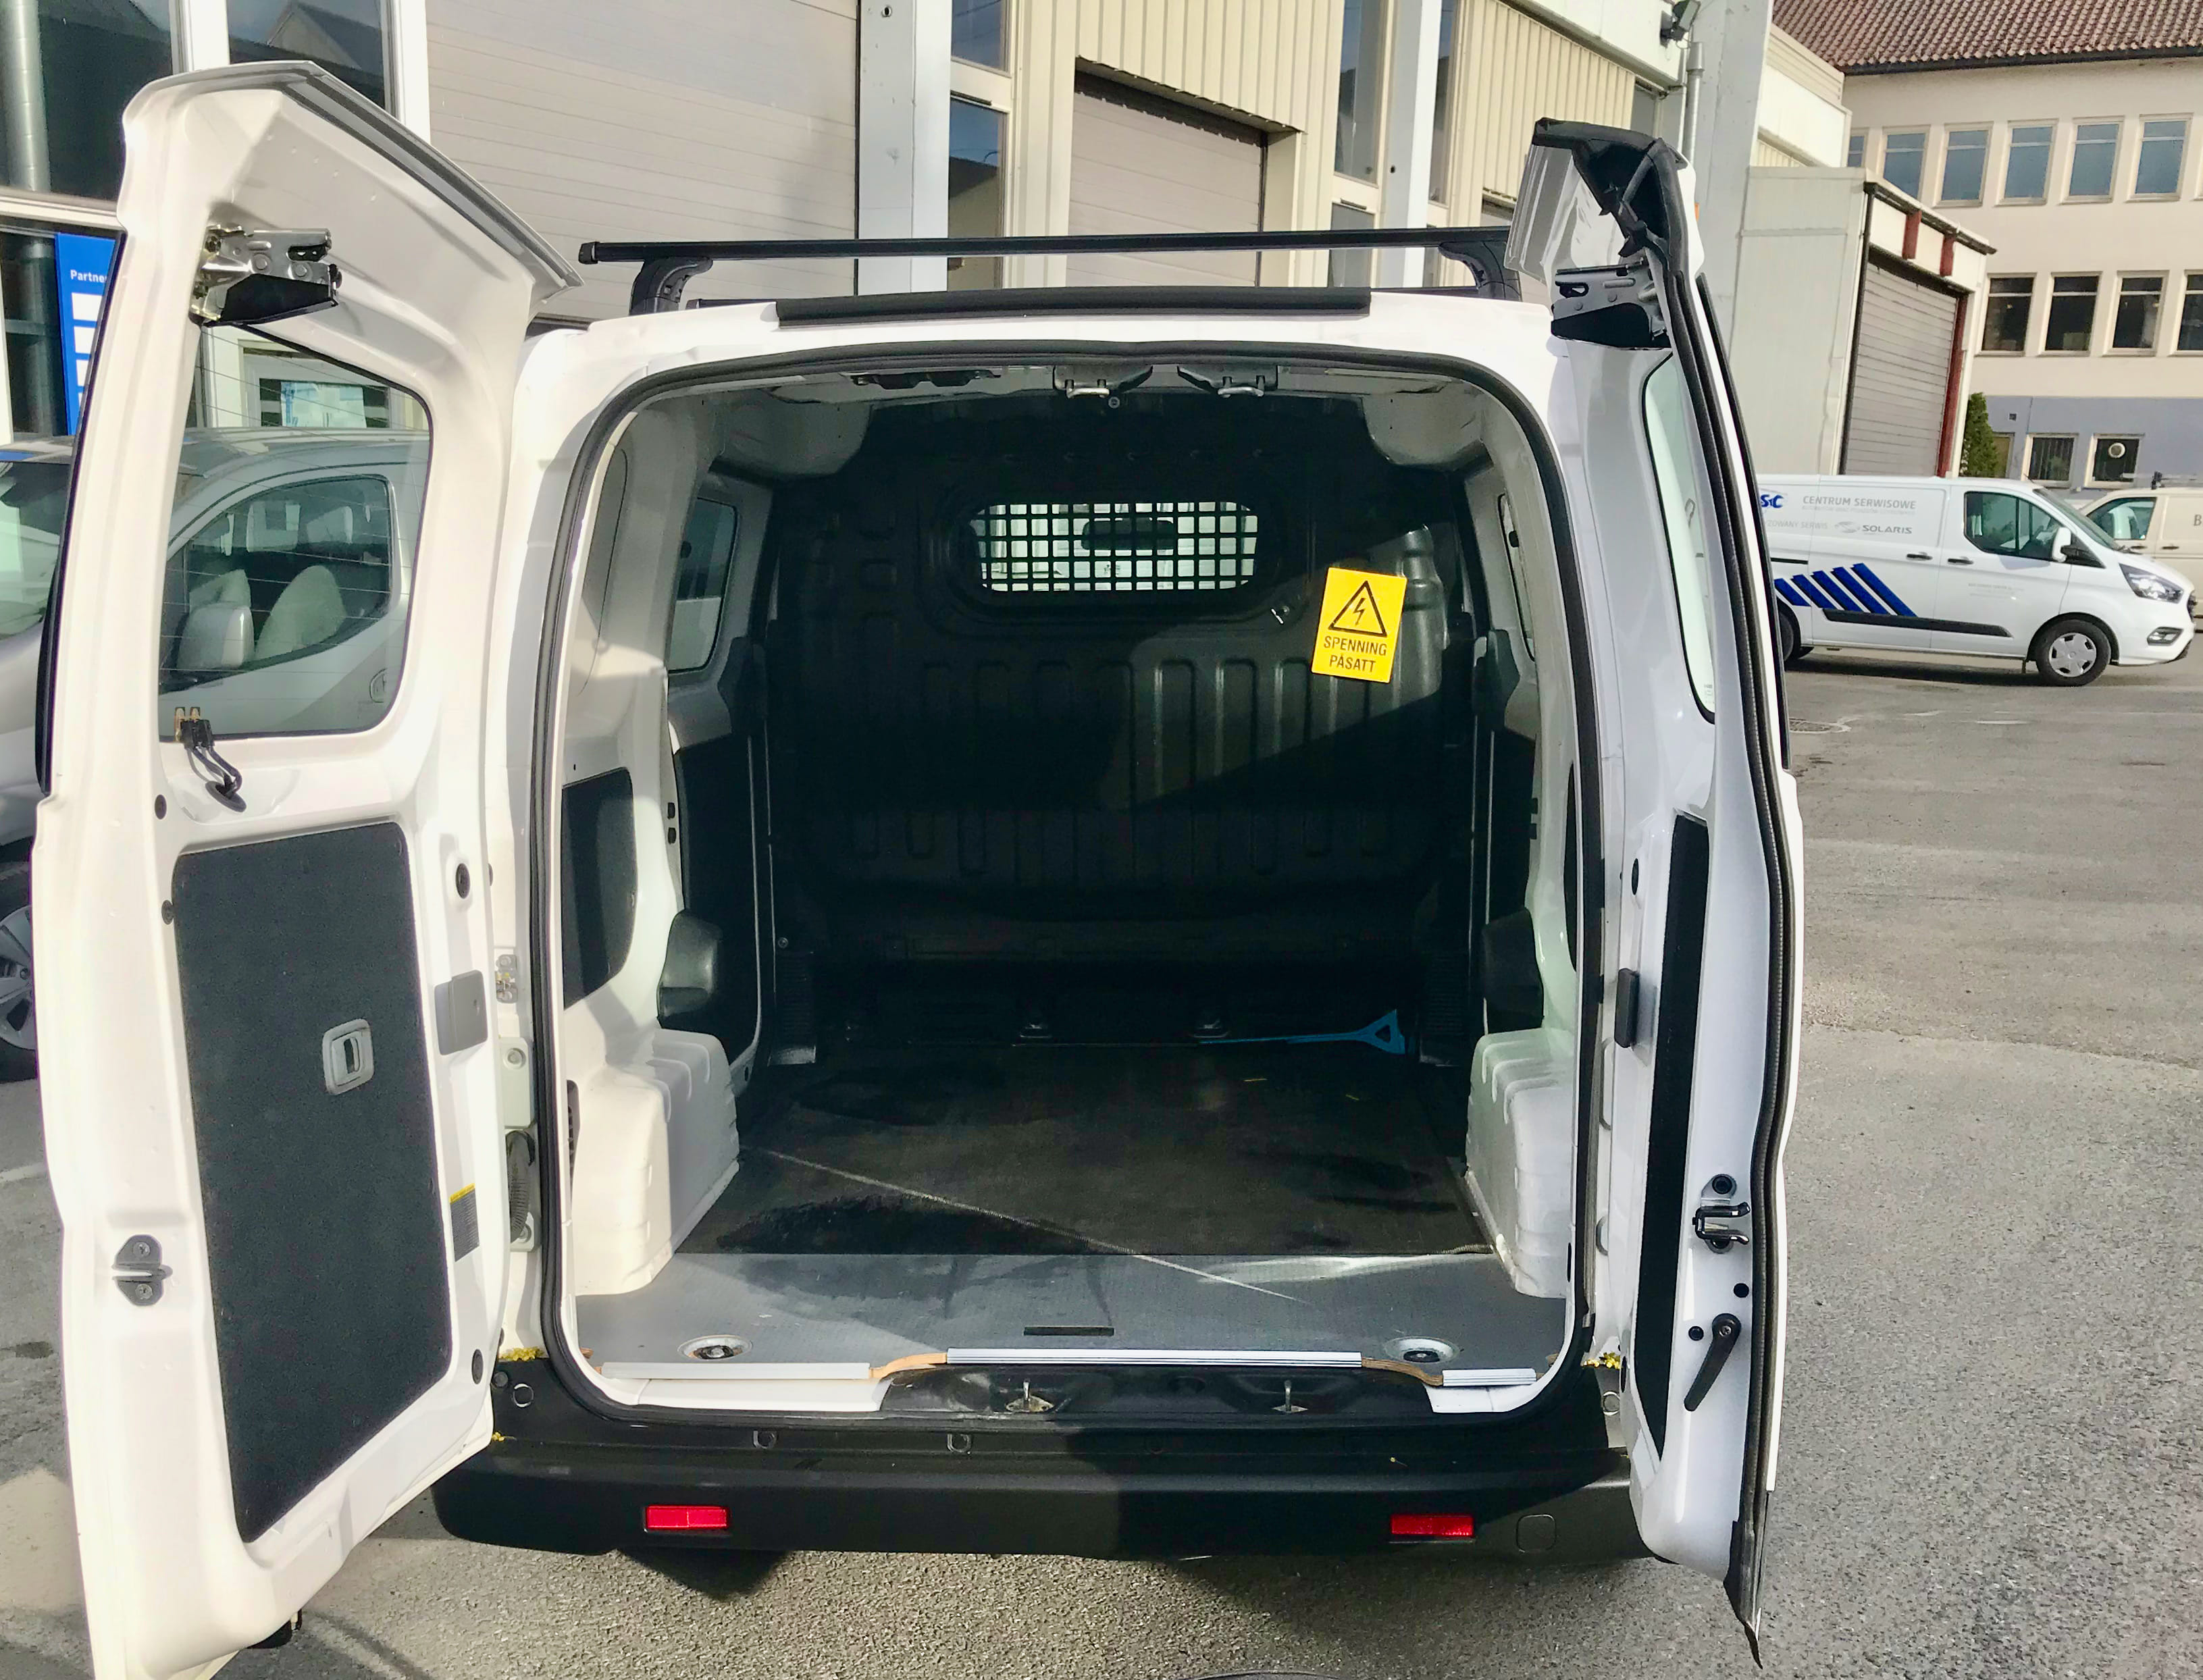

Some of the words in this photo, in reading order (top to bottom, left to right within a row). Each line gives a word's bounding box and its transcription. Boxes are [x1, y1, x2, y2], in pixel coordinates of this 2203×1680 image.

[1803, 496, 1850, 506] CENTRUM
[1854, 498, 1917, 509] SERWISOWE
[1862, 525, 1913, 534] SOLARIS
[1324, 635, 1387, 656] SPENNING
[1329, 653, 1376, 673] PÅSATT
